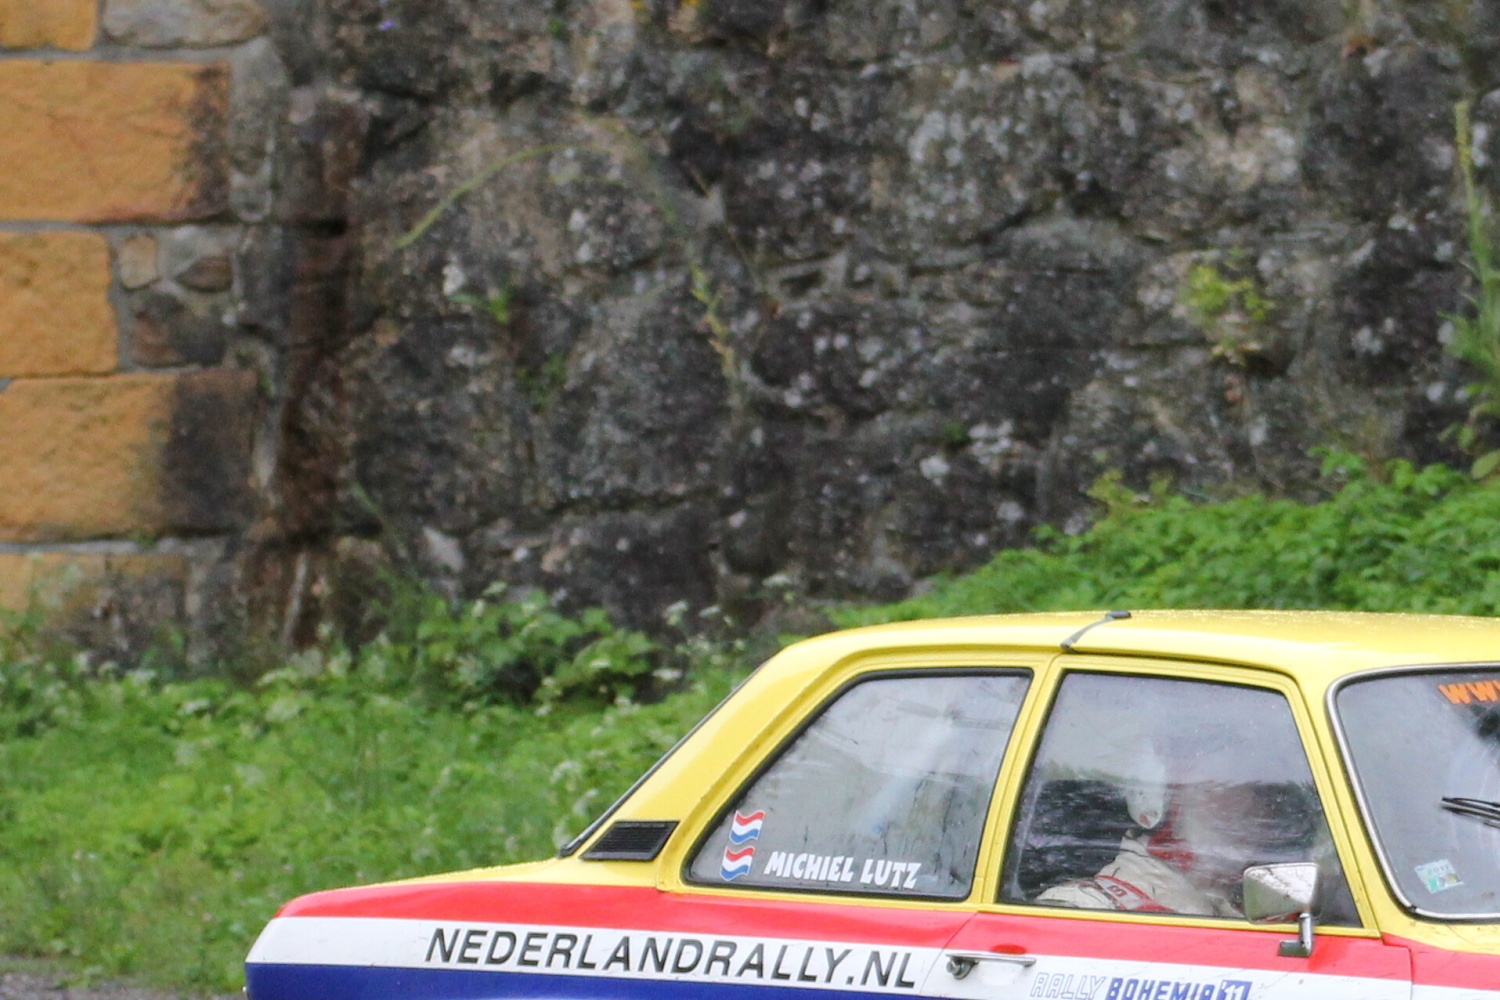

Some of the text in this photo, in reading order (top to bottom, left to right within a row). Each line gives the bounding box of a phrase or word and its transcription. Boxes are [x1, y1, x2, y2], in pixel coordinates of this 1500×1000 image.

[764, 851, 922, 889] MICHIEL LUTZ
[425, 927, 917, 989] NEDERLANDRALLY.NL
[1030, 972, 1106, 1000] RALLY
